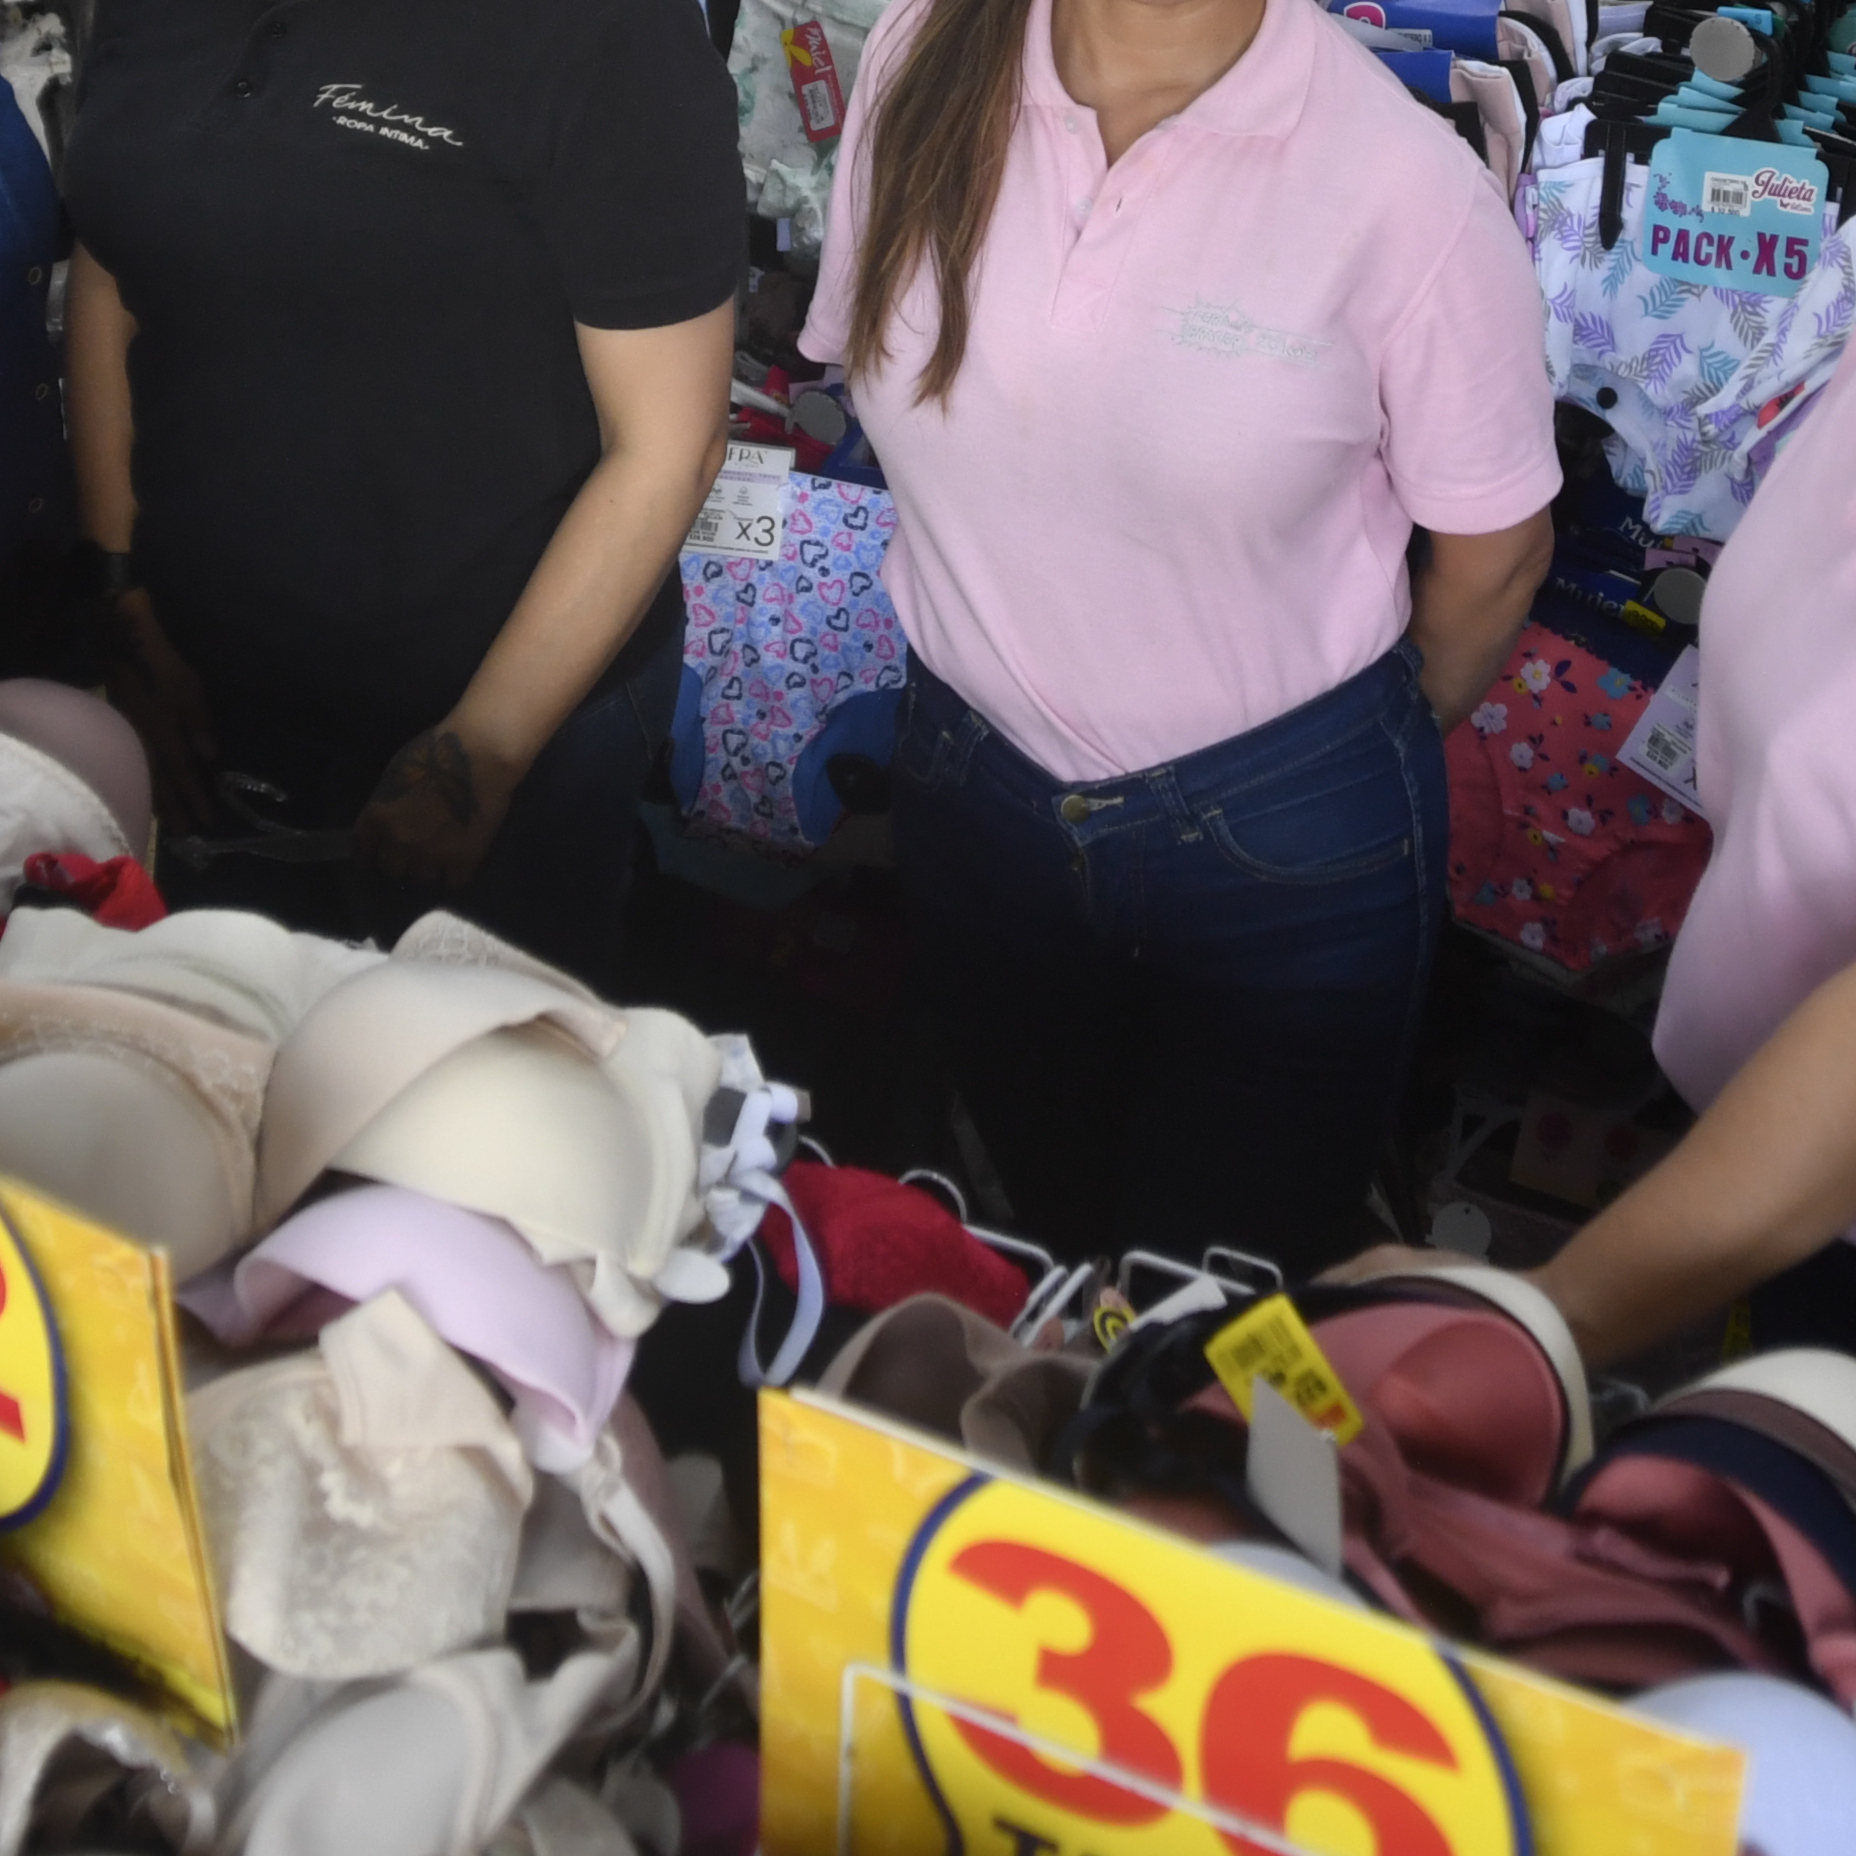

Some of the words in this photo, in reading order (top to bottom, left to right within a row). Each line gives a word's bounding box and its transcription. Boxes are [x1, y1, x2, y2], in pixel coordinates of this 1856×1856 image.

[1751, 169, 1816, 203] Julieta
[1651, 223, 1736, 271] PACK
[946, 1538, 1461, 1856] 36
